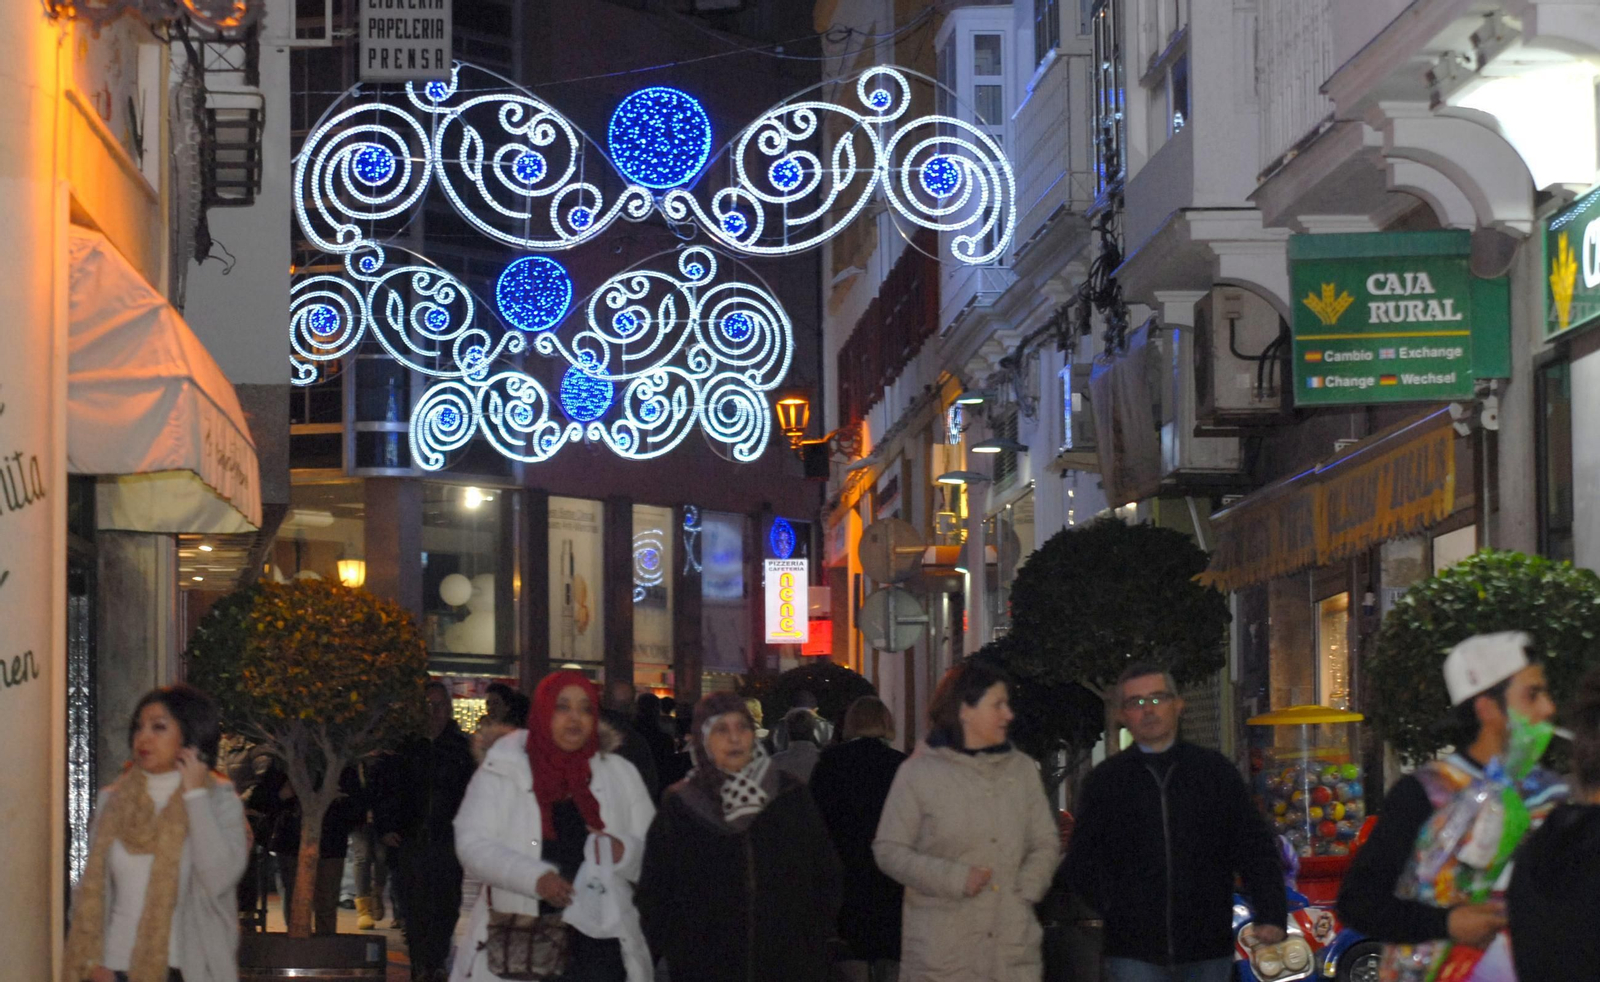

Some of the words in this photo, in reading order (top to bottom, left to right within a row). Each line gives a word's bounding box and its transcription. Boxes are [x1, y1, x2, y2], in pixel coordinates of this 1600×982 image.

[369, 18, 444, 39] PAPELERIA
[368, 48, 444, 69] PRENSA
[1366, 272, 1436, 296] CAJA
[1368, 298, 1463, 324] RURAL
[1324, 350, 1373, 362] Cambio
[1399, 346, 1463, 360] Exchange
[1325, 375, 1375, 388] Change
[1401, 373, 1456, 385] Wechsel
[779, 572, 795, 632] nene
